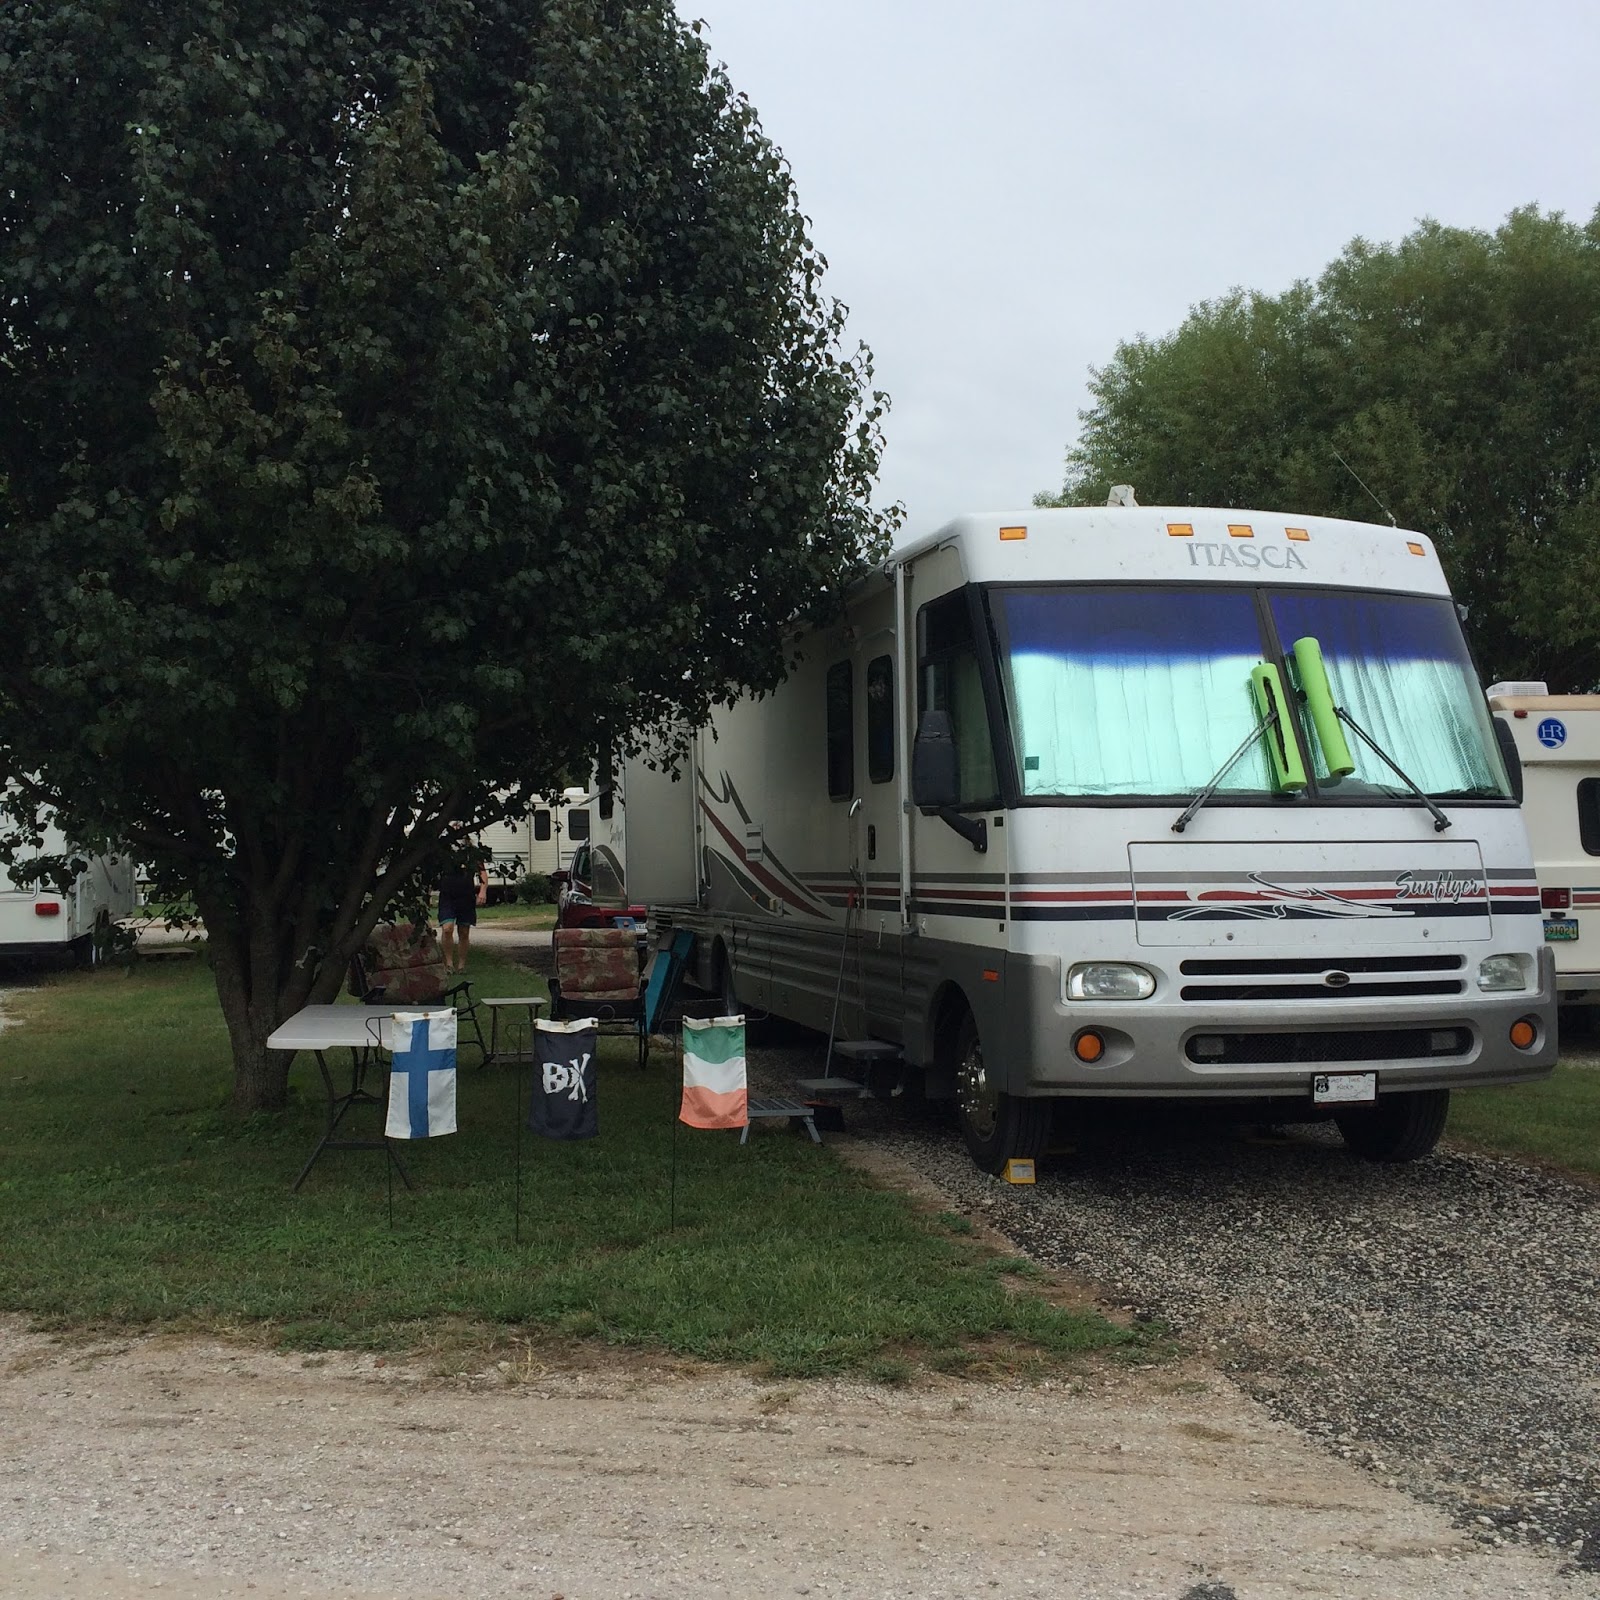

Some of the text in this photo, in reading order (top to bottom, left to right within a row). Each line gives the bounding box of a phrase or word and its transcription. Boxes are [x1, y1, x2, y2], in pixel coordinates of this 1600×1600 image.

[1186, 542, 1308, 570] ITASCA
[1540, 724, 1563, 738] HR
[1395, 870, 1481, 904] Sunflyer
